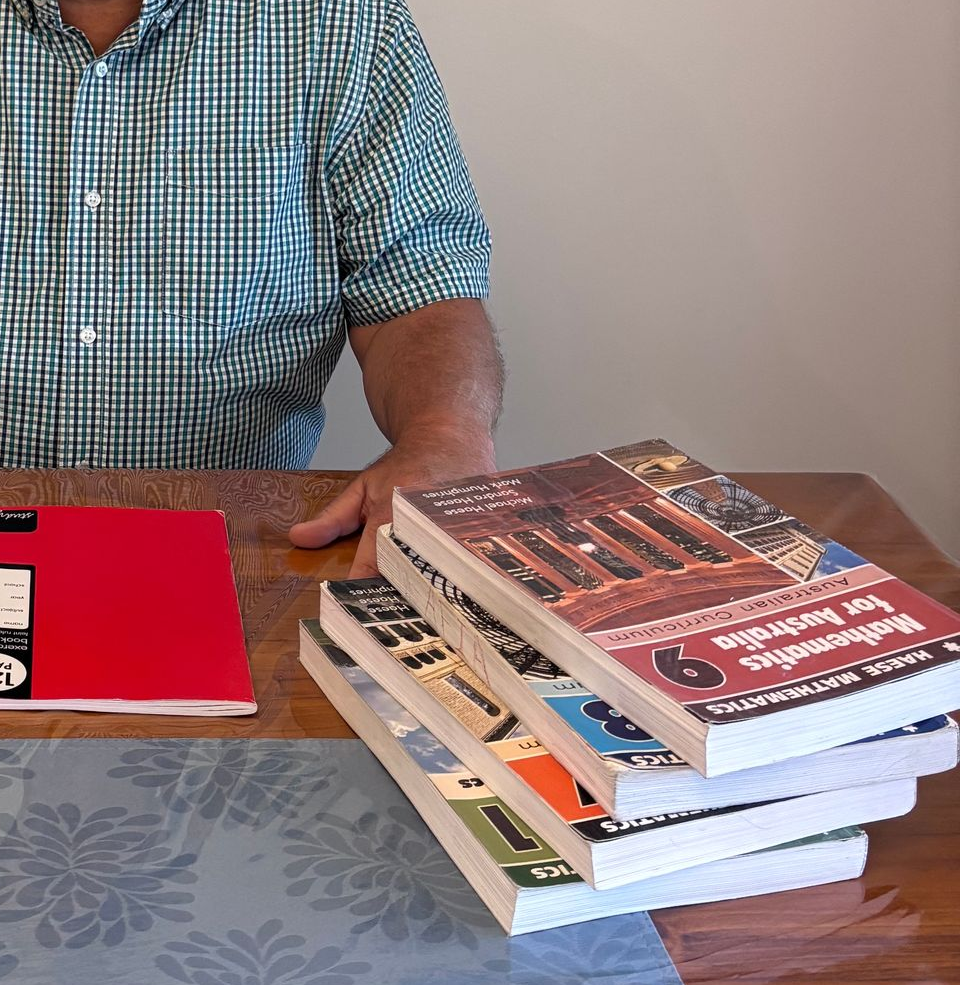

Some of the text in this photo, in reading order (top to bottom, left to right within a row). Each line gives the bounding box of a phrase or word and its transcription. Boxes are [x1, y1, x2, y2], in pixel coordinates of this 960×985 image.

[422, 478, 522, 500] Mark Humphries
[433, 489, 519, 507] Sandra Haese
[444, 497, 533, 516] Michael Haese
[359, 595, 401, 604] Haese
[368, 604, 410, 614] Haese
[607, 576, 849, 642] Australian Curriculum
[710, 594, 896, 652] for Australia
[0, 636, 28, 644] book
[738, 613, 927, 672] Mathematics
[705, 649, 934, 716] HAESE MATHEMATICS
